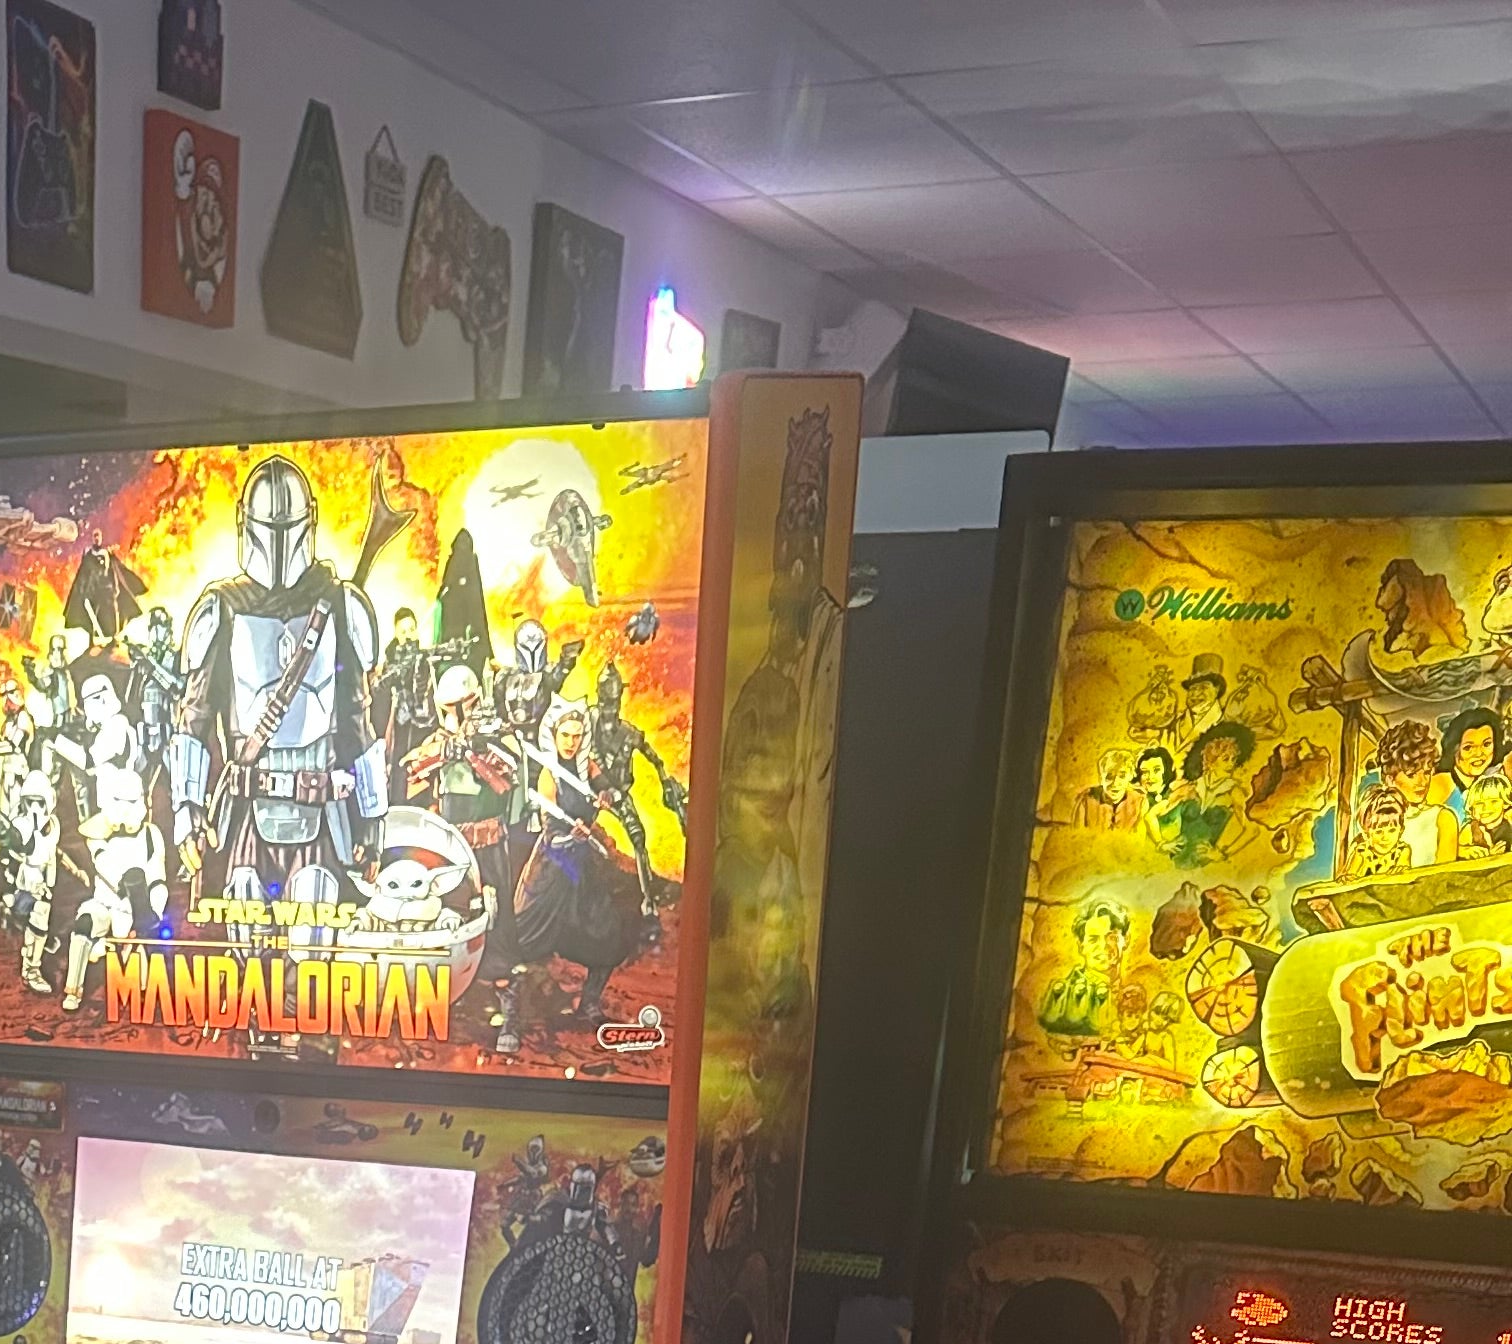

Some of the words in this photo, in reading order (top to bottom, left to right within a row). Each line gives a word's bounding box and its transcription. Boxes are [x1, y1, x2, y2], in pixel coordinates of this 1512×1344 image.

[1147, 585, 1293, 622] Williams
[188, 899, 271, 925] STAR
[272, 901, 357, 928] WARS
[251, 935, 288, 950] THE
[1387, 927, 1451, 968] THE
[106, 950, 452, 1041] MANDALORIAN
[181, 1242, 248, 1281] EXTRA
[252, 1250, 307, 1289] BALL
[310, 1256, 343, 1290] AT
[174, 1282, 343, 1335] 460,000,000
[1333, 1297, 1406, 1321] HIGH
